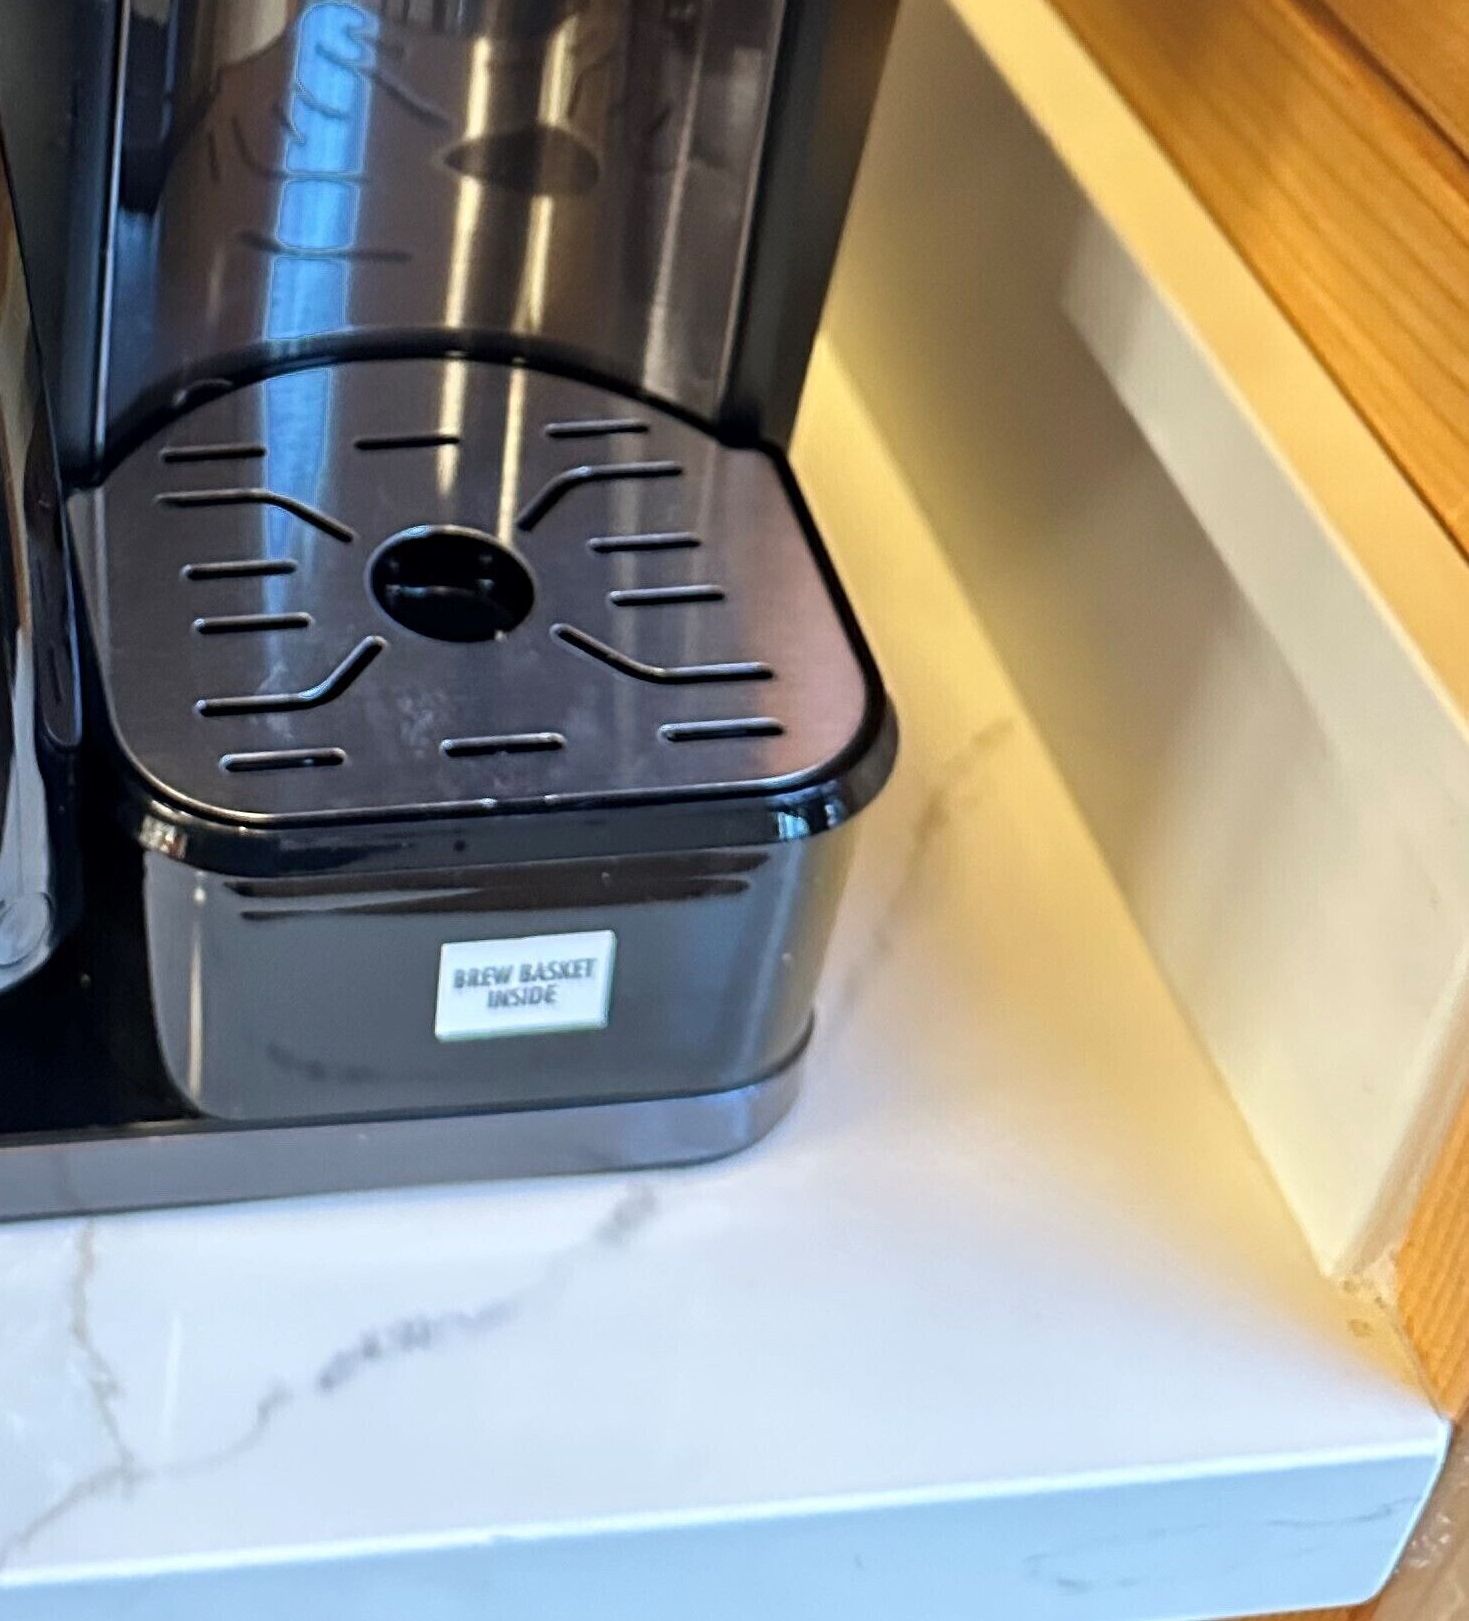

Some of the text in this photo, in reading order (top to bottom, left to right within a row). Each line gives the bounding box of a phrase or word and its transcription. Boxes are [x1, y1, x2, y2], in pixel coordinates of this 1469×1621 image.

[454, 958, 597, 988] BREW BASKET
[488, 985, 558, 1008] INSIDE
